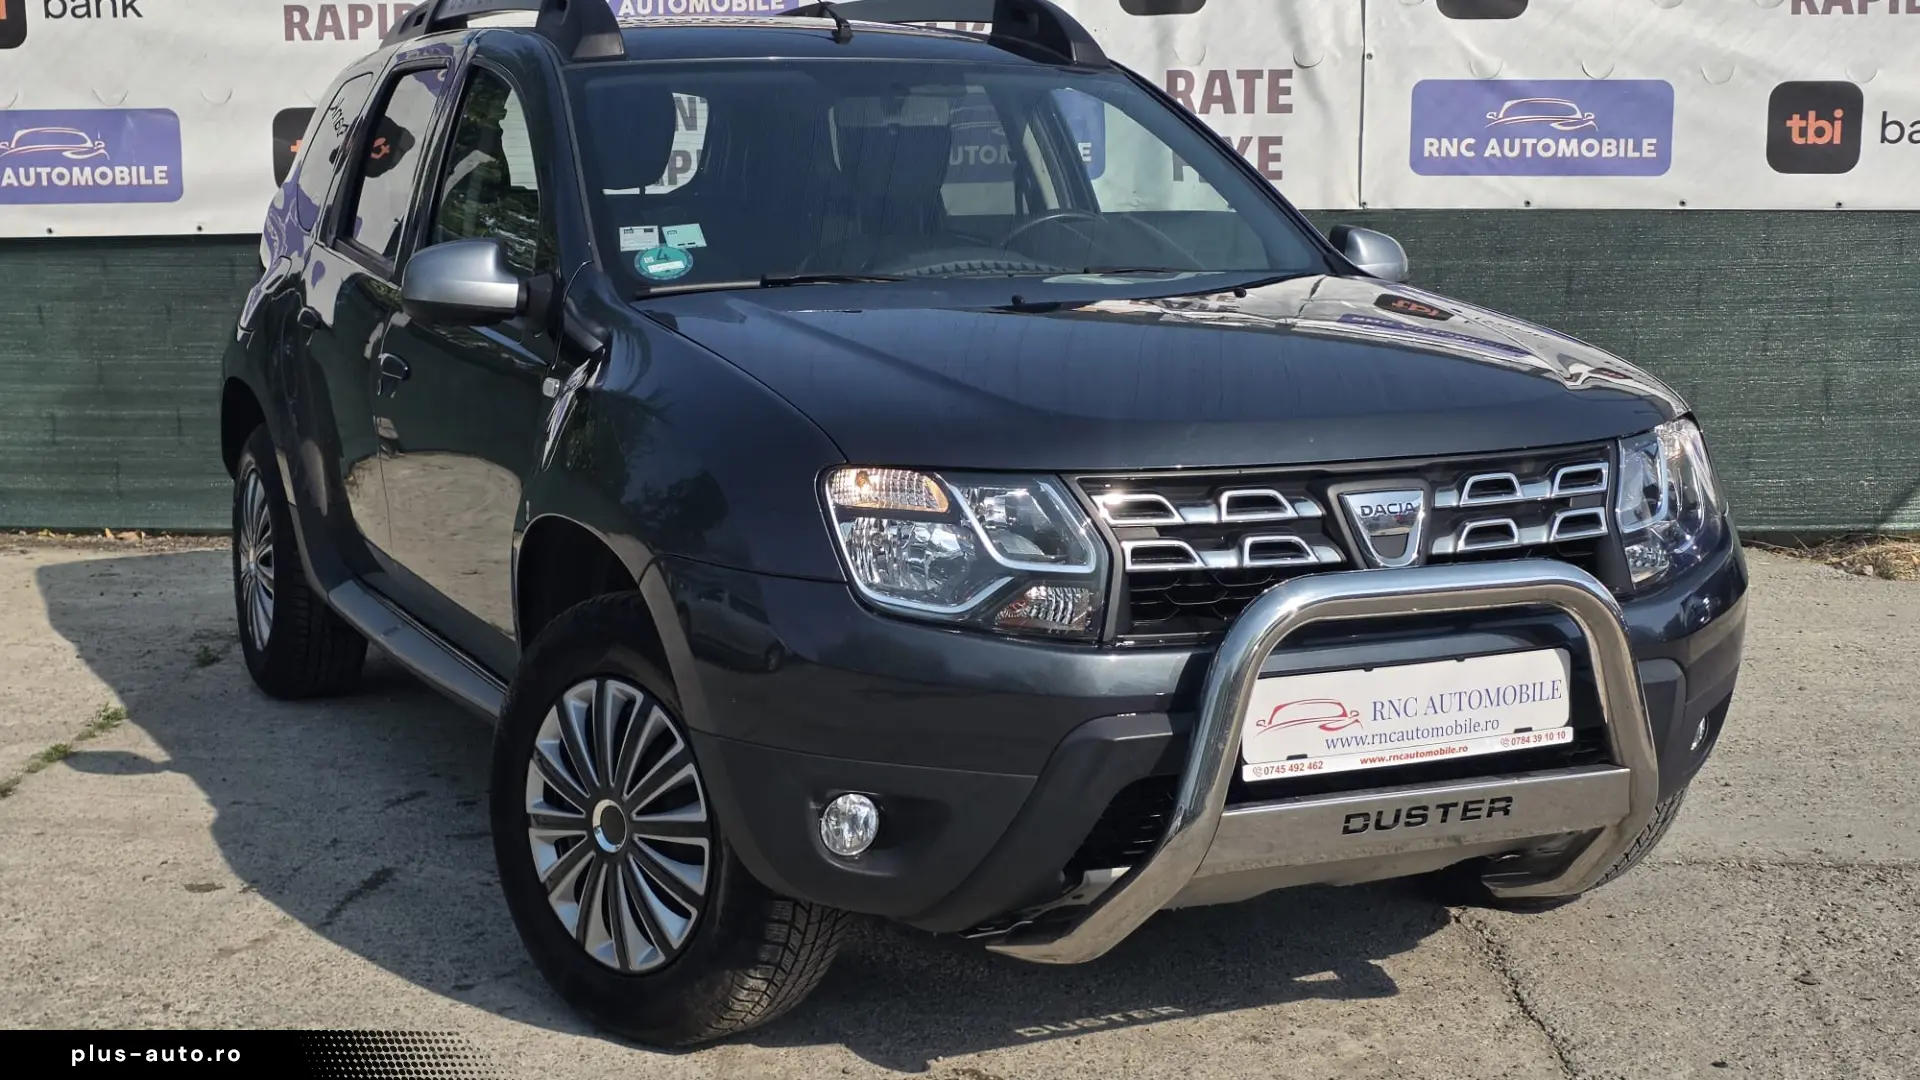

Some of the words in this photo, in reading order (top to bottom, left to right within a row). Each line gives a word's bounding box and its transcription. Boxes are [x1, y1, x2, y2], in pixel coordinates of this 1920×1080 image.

[44, 0, 143, 19] bank
[1166, 69, 1293, 115] RATE
[1786, 108, 1844, 145] tbi
[1423, 137, 1476, 158] RNC
[1483, 137, 1657, 158] AUTOMOBILE
[1, 165, 169, 187] AUTOMOBILE
[1360, 502, 1416, 517] DACIA
[1371, 696, 1419, 722] RNC
[1423, 679, 1562, 716] AUTOMOBILE
[1325, 717, 1500, 750] www.rncautomobile.ro
[1511, 735, 1531, 746] 0784
[1532, 734, 1543, 743] 39
[1545, 732, 1554, 742] 10
[1557, 730, 1566, 740] 10
[1359, 745, 1469, 765] www.rncautomobile.ro
[1263, 766, 1286, 776] 0745
[1288, 763, 1305, 773] 492
[1307, 760, 1324, 771] 462
[1341, 796, 1514, 836] DUSTER
